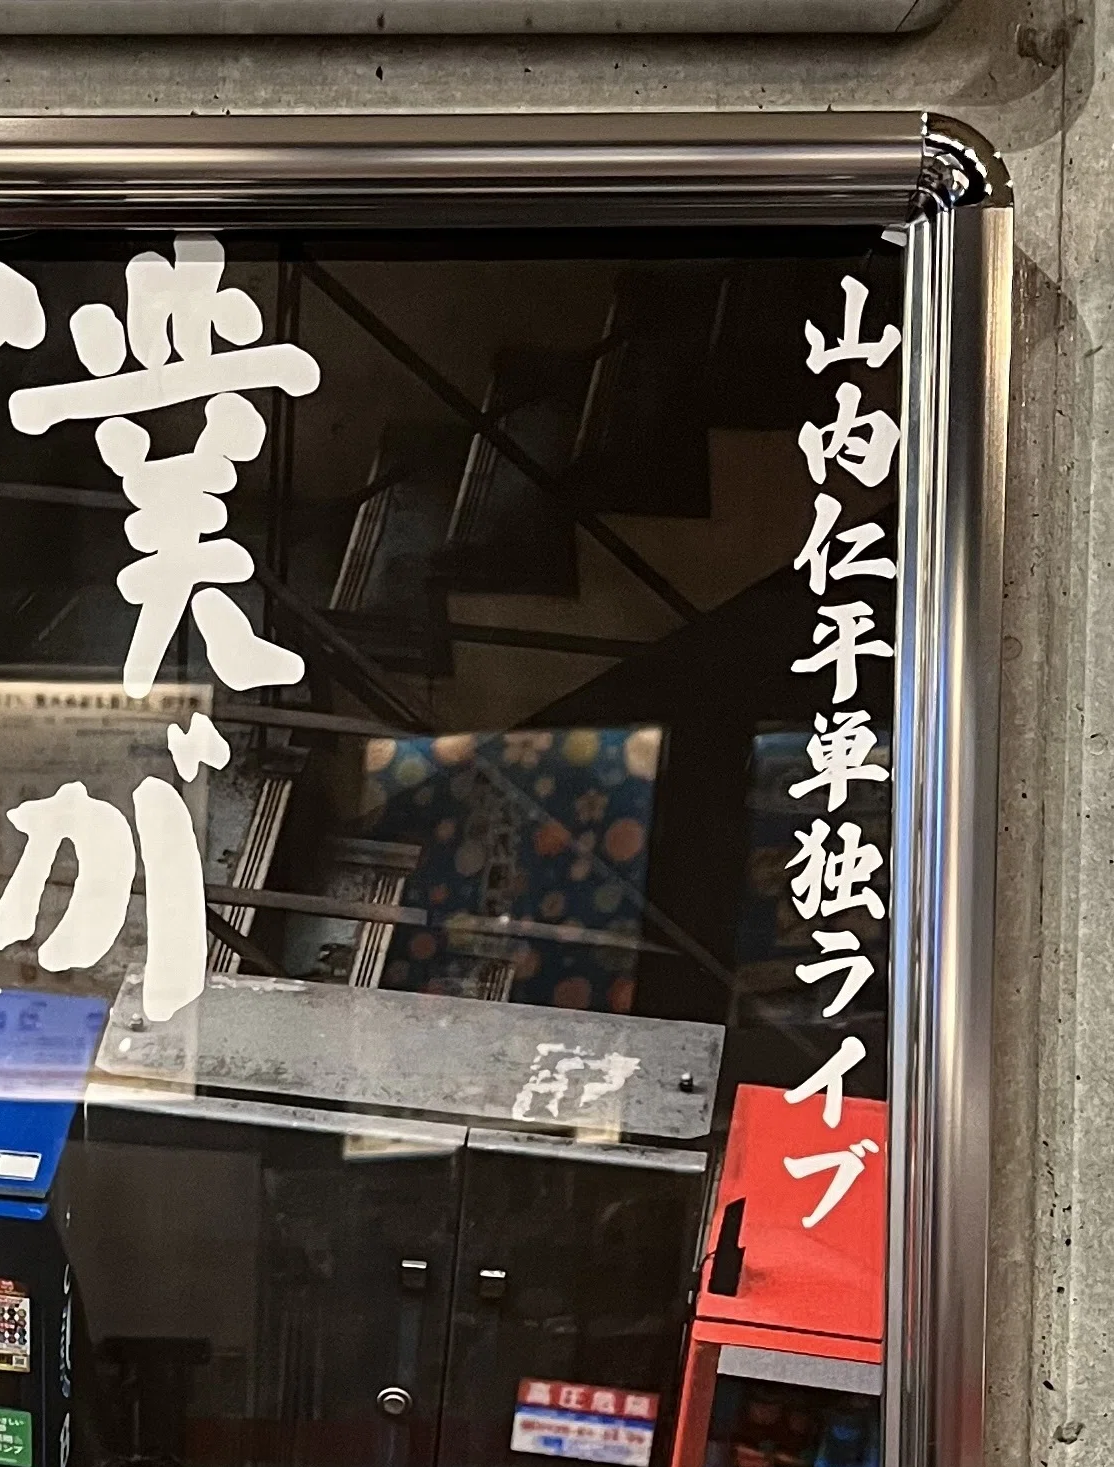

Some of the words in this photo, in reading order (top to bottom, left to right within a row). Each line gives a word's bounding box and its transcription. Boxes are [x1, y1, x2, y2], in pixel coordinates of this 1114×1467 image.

[784, 274, 902, 1229] 山内仁平単独ライブ
